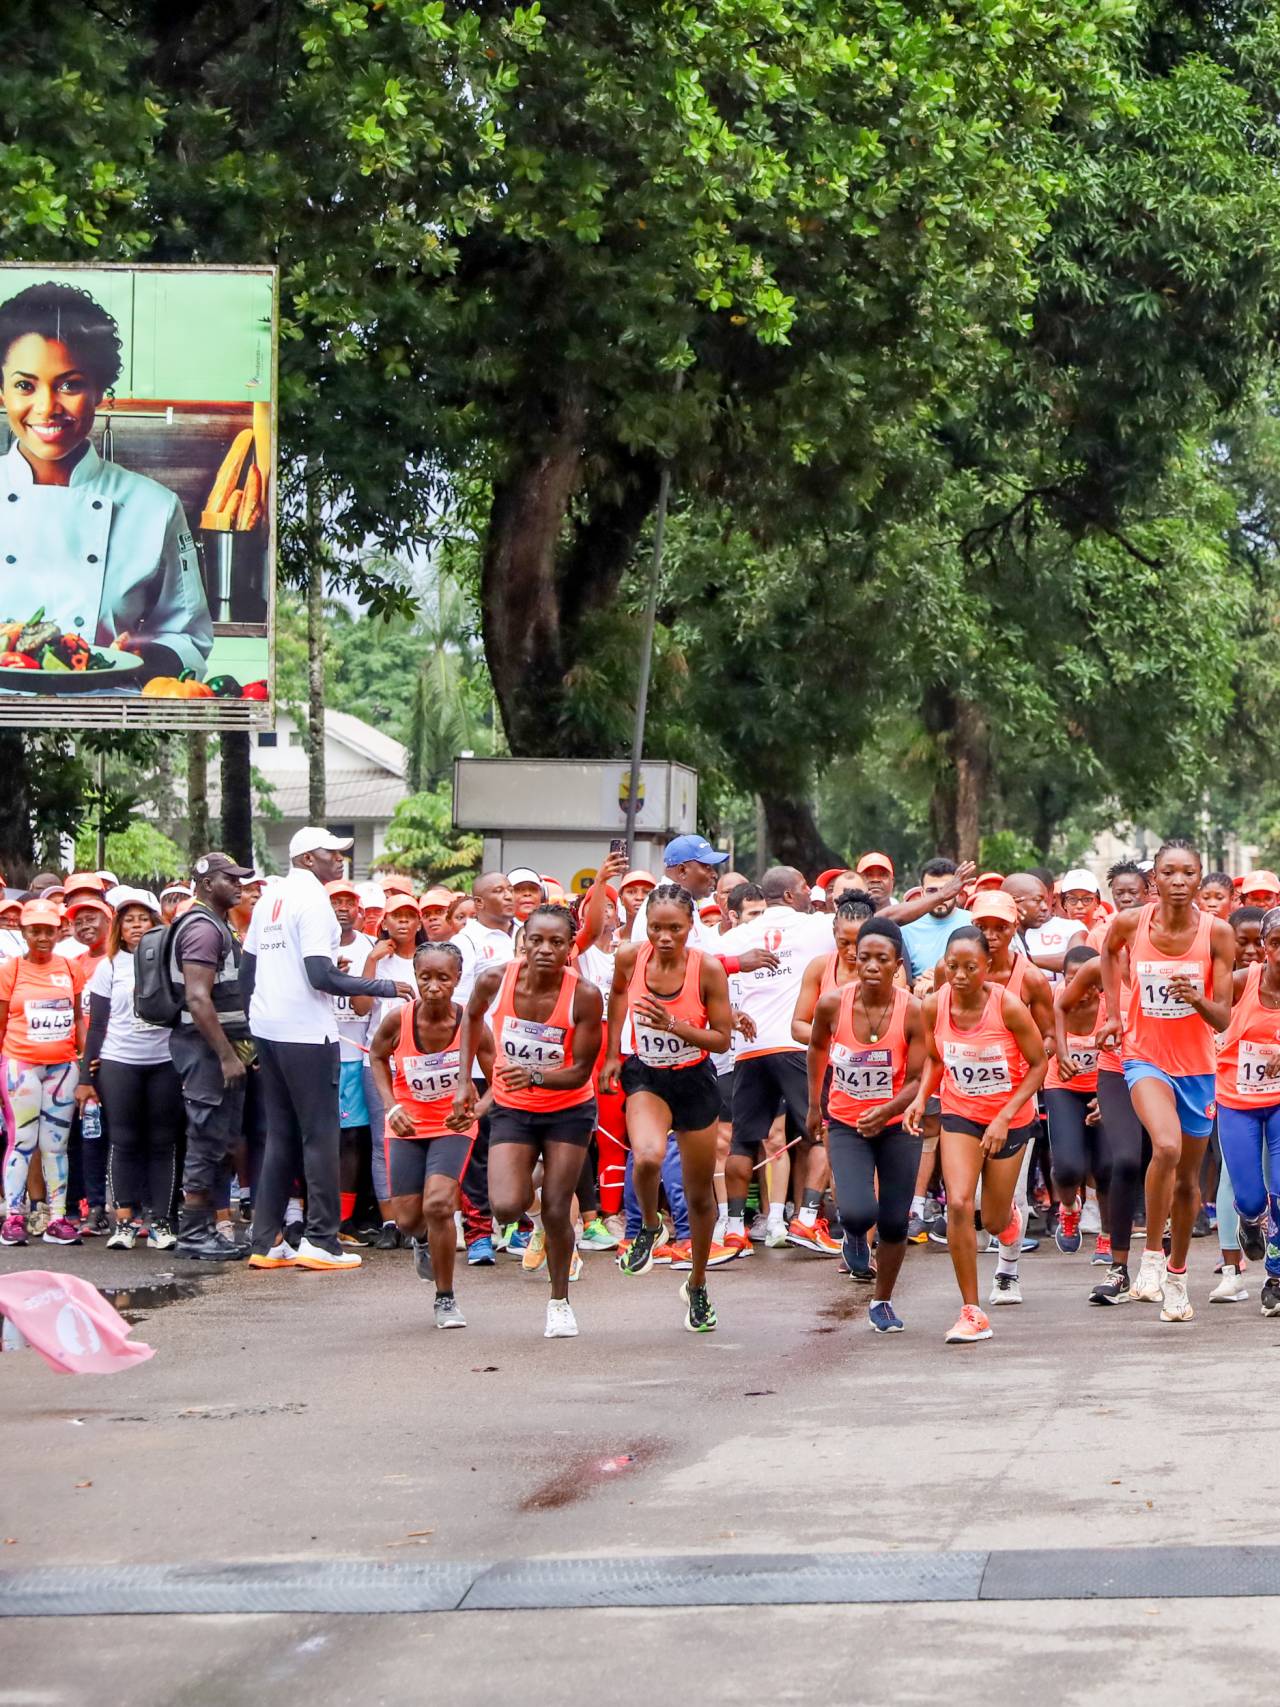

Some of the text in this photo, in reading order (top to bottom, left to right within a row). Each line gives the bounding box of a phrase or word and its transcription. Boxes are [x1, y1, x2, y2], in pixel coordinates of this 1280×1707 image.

[31, 1014, 71, 1029] 0445
[505, 1041, 560, 1061] 0416
[836, 1066, 888, 1087] 0412
[950, 1066, 1006, 1084] 1925
